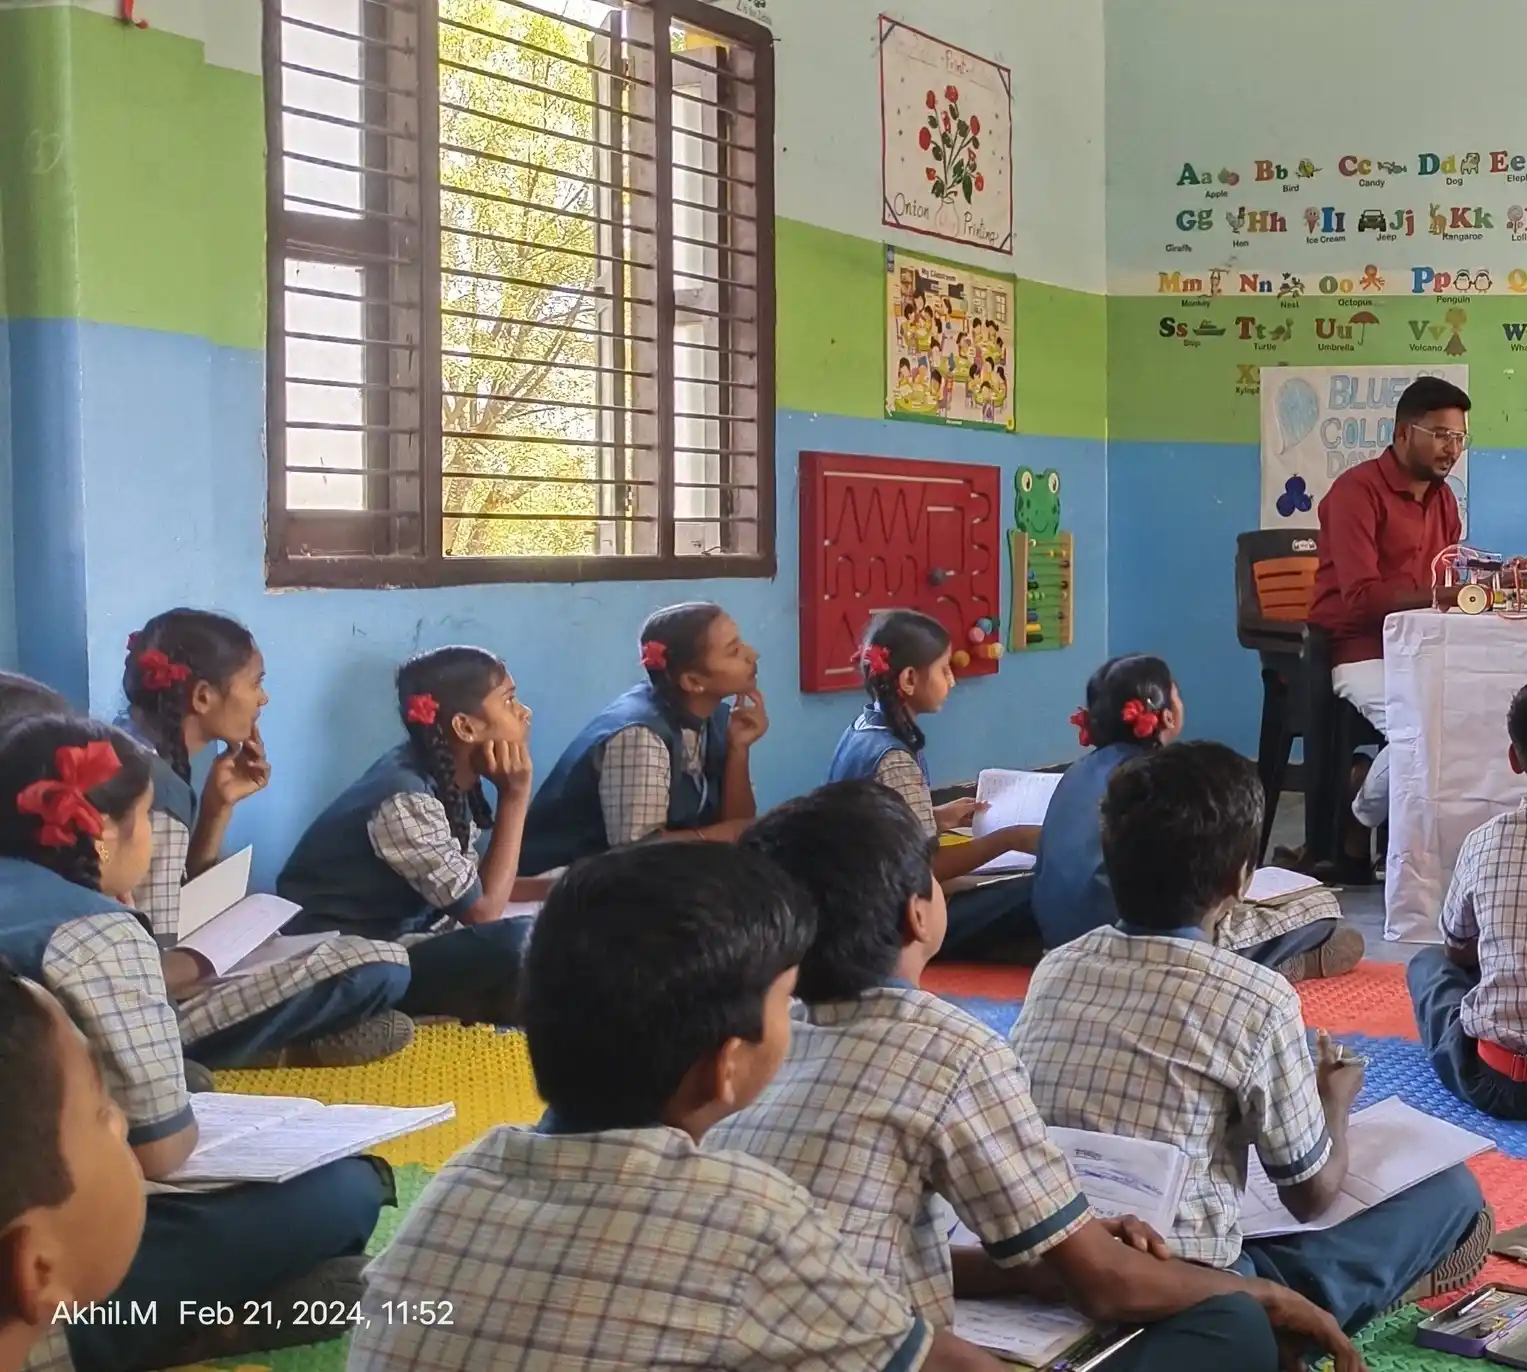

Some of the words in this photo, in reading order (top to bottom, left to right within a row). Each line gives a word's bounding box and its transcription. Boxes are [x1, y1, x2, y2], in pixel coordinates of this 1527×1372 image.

[1254, 159, 1289, 181] Bb
[1338, 155, 1372, 177] Cc
[1418, 152, 1457, 175] Dd
[1489, 150, 1526, 173] Ee
[1176, 162, 1213, 186] Aa
[1358, 178, 1385, 188] Candy
[1446, 177, 1463, 186] Dog
[1205, 189, 1229, 200] Apple
[1282, 184, 1300, 193] Bird
[894, 193, 929, 219] Onion
[964, 211, 999, 244] Printing
[1176, 208, 1214, 231] Gg
[1247, 210, 1288, 232] Hh
[1389, 208, 1415, 236] Jj
[1449, 206, 1494, 229] Kk
[1320, 235, 1346, 243] Cream
[1376, 233, 1397, 242] Jeep
[1442, 233, 1483, 242] Kangaroo
[1158, 271, 1203, 293] Mm
[1239, 273, 1273, 293] Nn
[1319, 276, 1354, 294] Oo
[1411, 267, 1451, 293] Pp
[1338, 298, 1373, 308] Octopus
[1436, 295, 1471, 304] Penguin
[1159, 316, 1188, 337] Ss
[1235, 316, 1266, 340] Tt
[1315, 318, 1352, 340] Uu
[1408, 320, 1447, 341] Vv
[1253, 342, 1277, 351] Turtle
[1317, 343, 1355, 352] Umbrella
[1409, 343, 1443, 352] Volcano
[1328, 374, 1410, 410] BLUE
[1320, 417, 1396, 449] COLO
